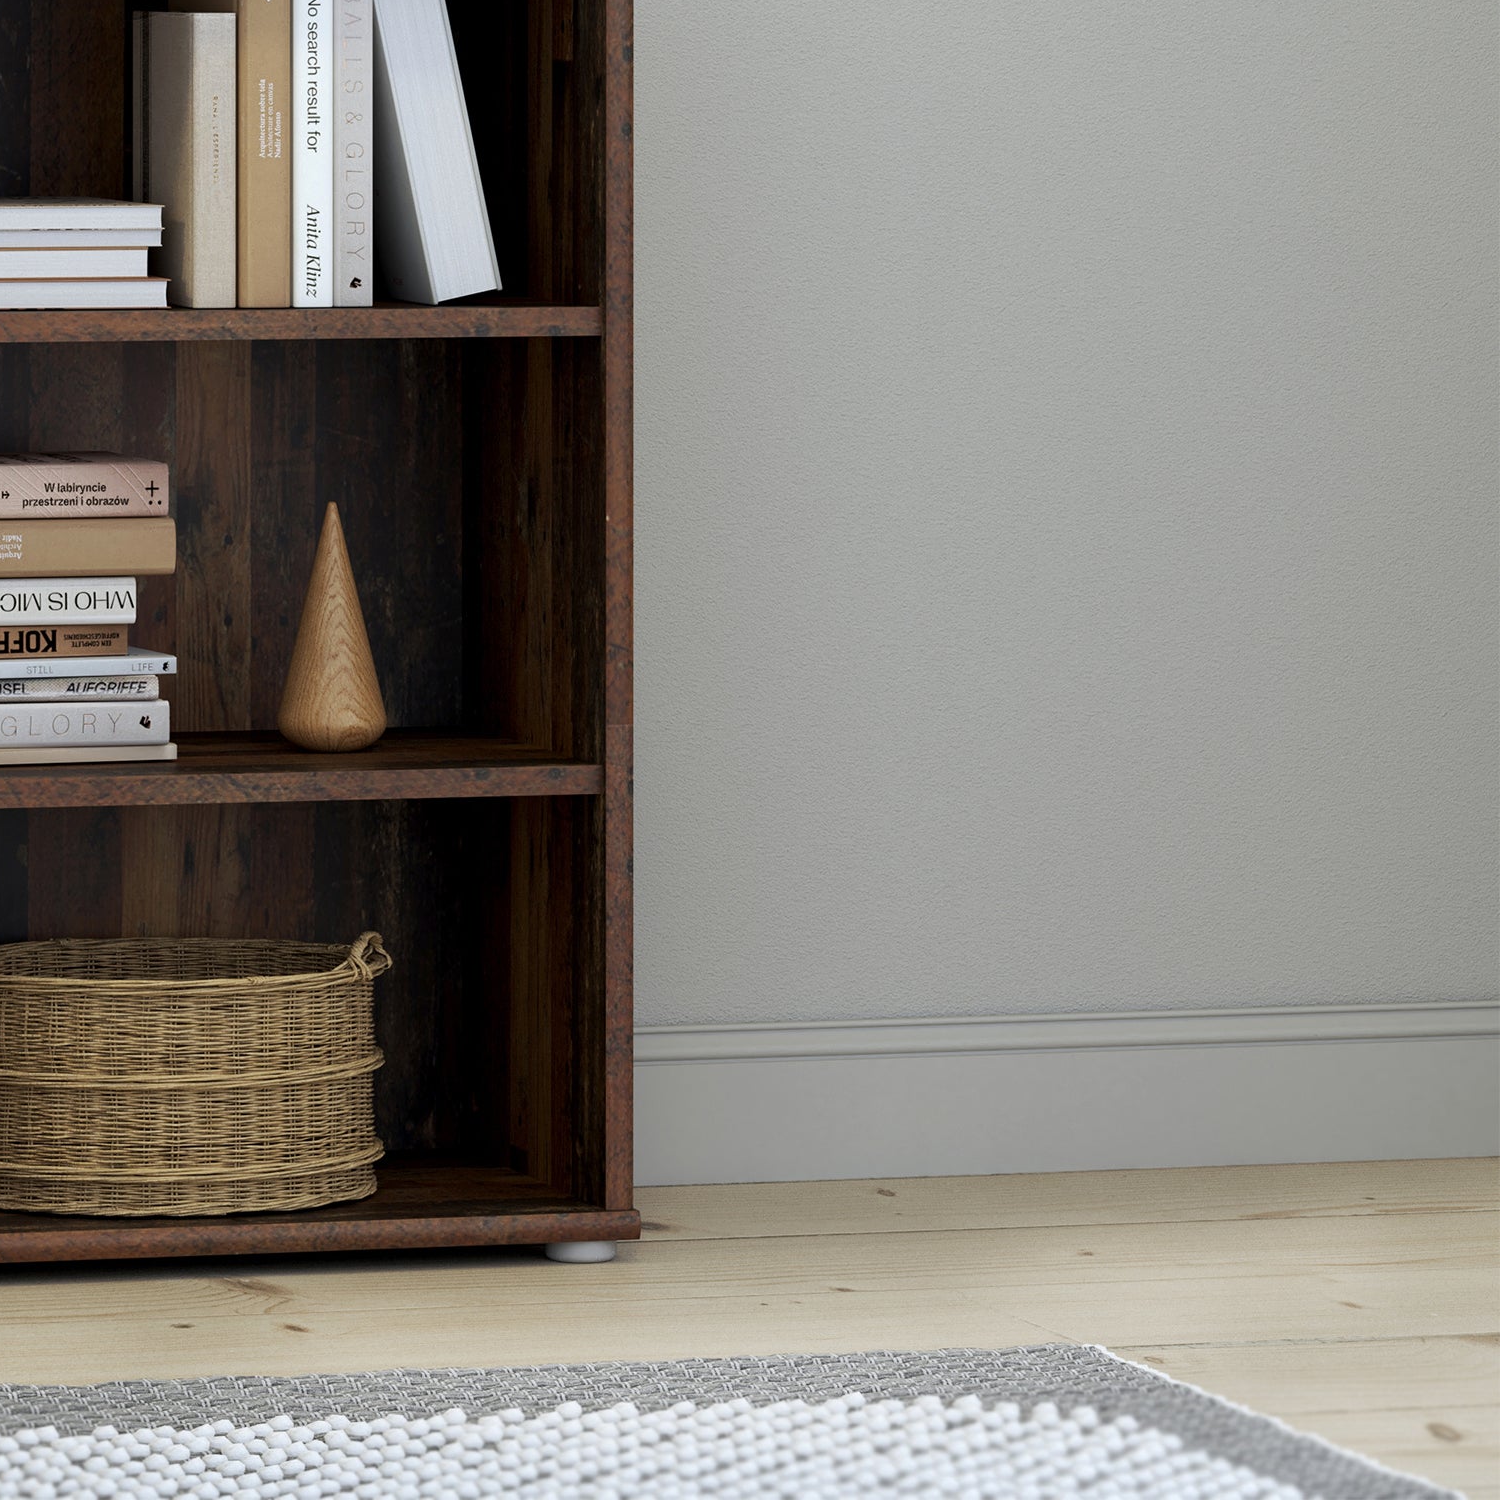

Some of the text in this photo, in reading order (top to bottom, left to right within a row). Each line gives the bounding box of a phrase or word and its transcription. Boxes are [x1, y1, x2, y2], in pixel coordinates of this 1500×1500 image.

[307, 22, 321, 76] search
[267, 106, 273, 116] on
[306, 80, 321, 125] result
[258, 78, 267, 158] Arquitectura sobre tela
[345, 111, 363, 124] &
[306, 131, 321, 153] for
[345, 142, 365, 260] GLORY
[305, 204, 321, 298] Anita Klinz
[44, 482, 107, 495] W labiryncie
[22, 497, 78, 509] przestrzeni
[85, 496, 130, 506] obrazów
[48, 592, 68, 611] IS
[74, 591, 135, 610] WHO
[26, 665, 54, 674] STILL
[131, 662, 153, 672] LIFE
[65, 681, 148, 694] AUFGRIFFE
[0, 712, 122, 737] GLORY
